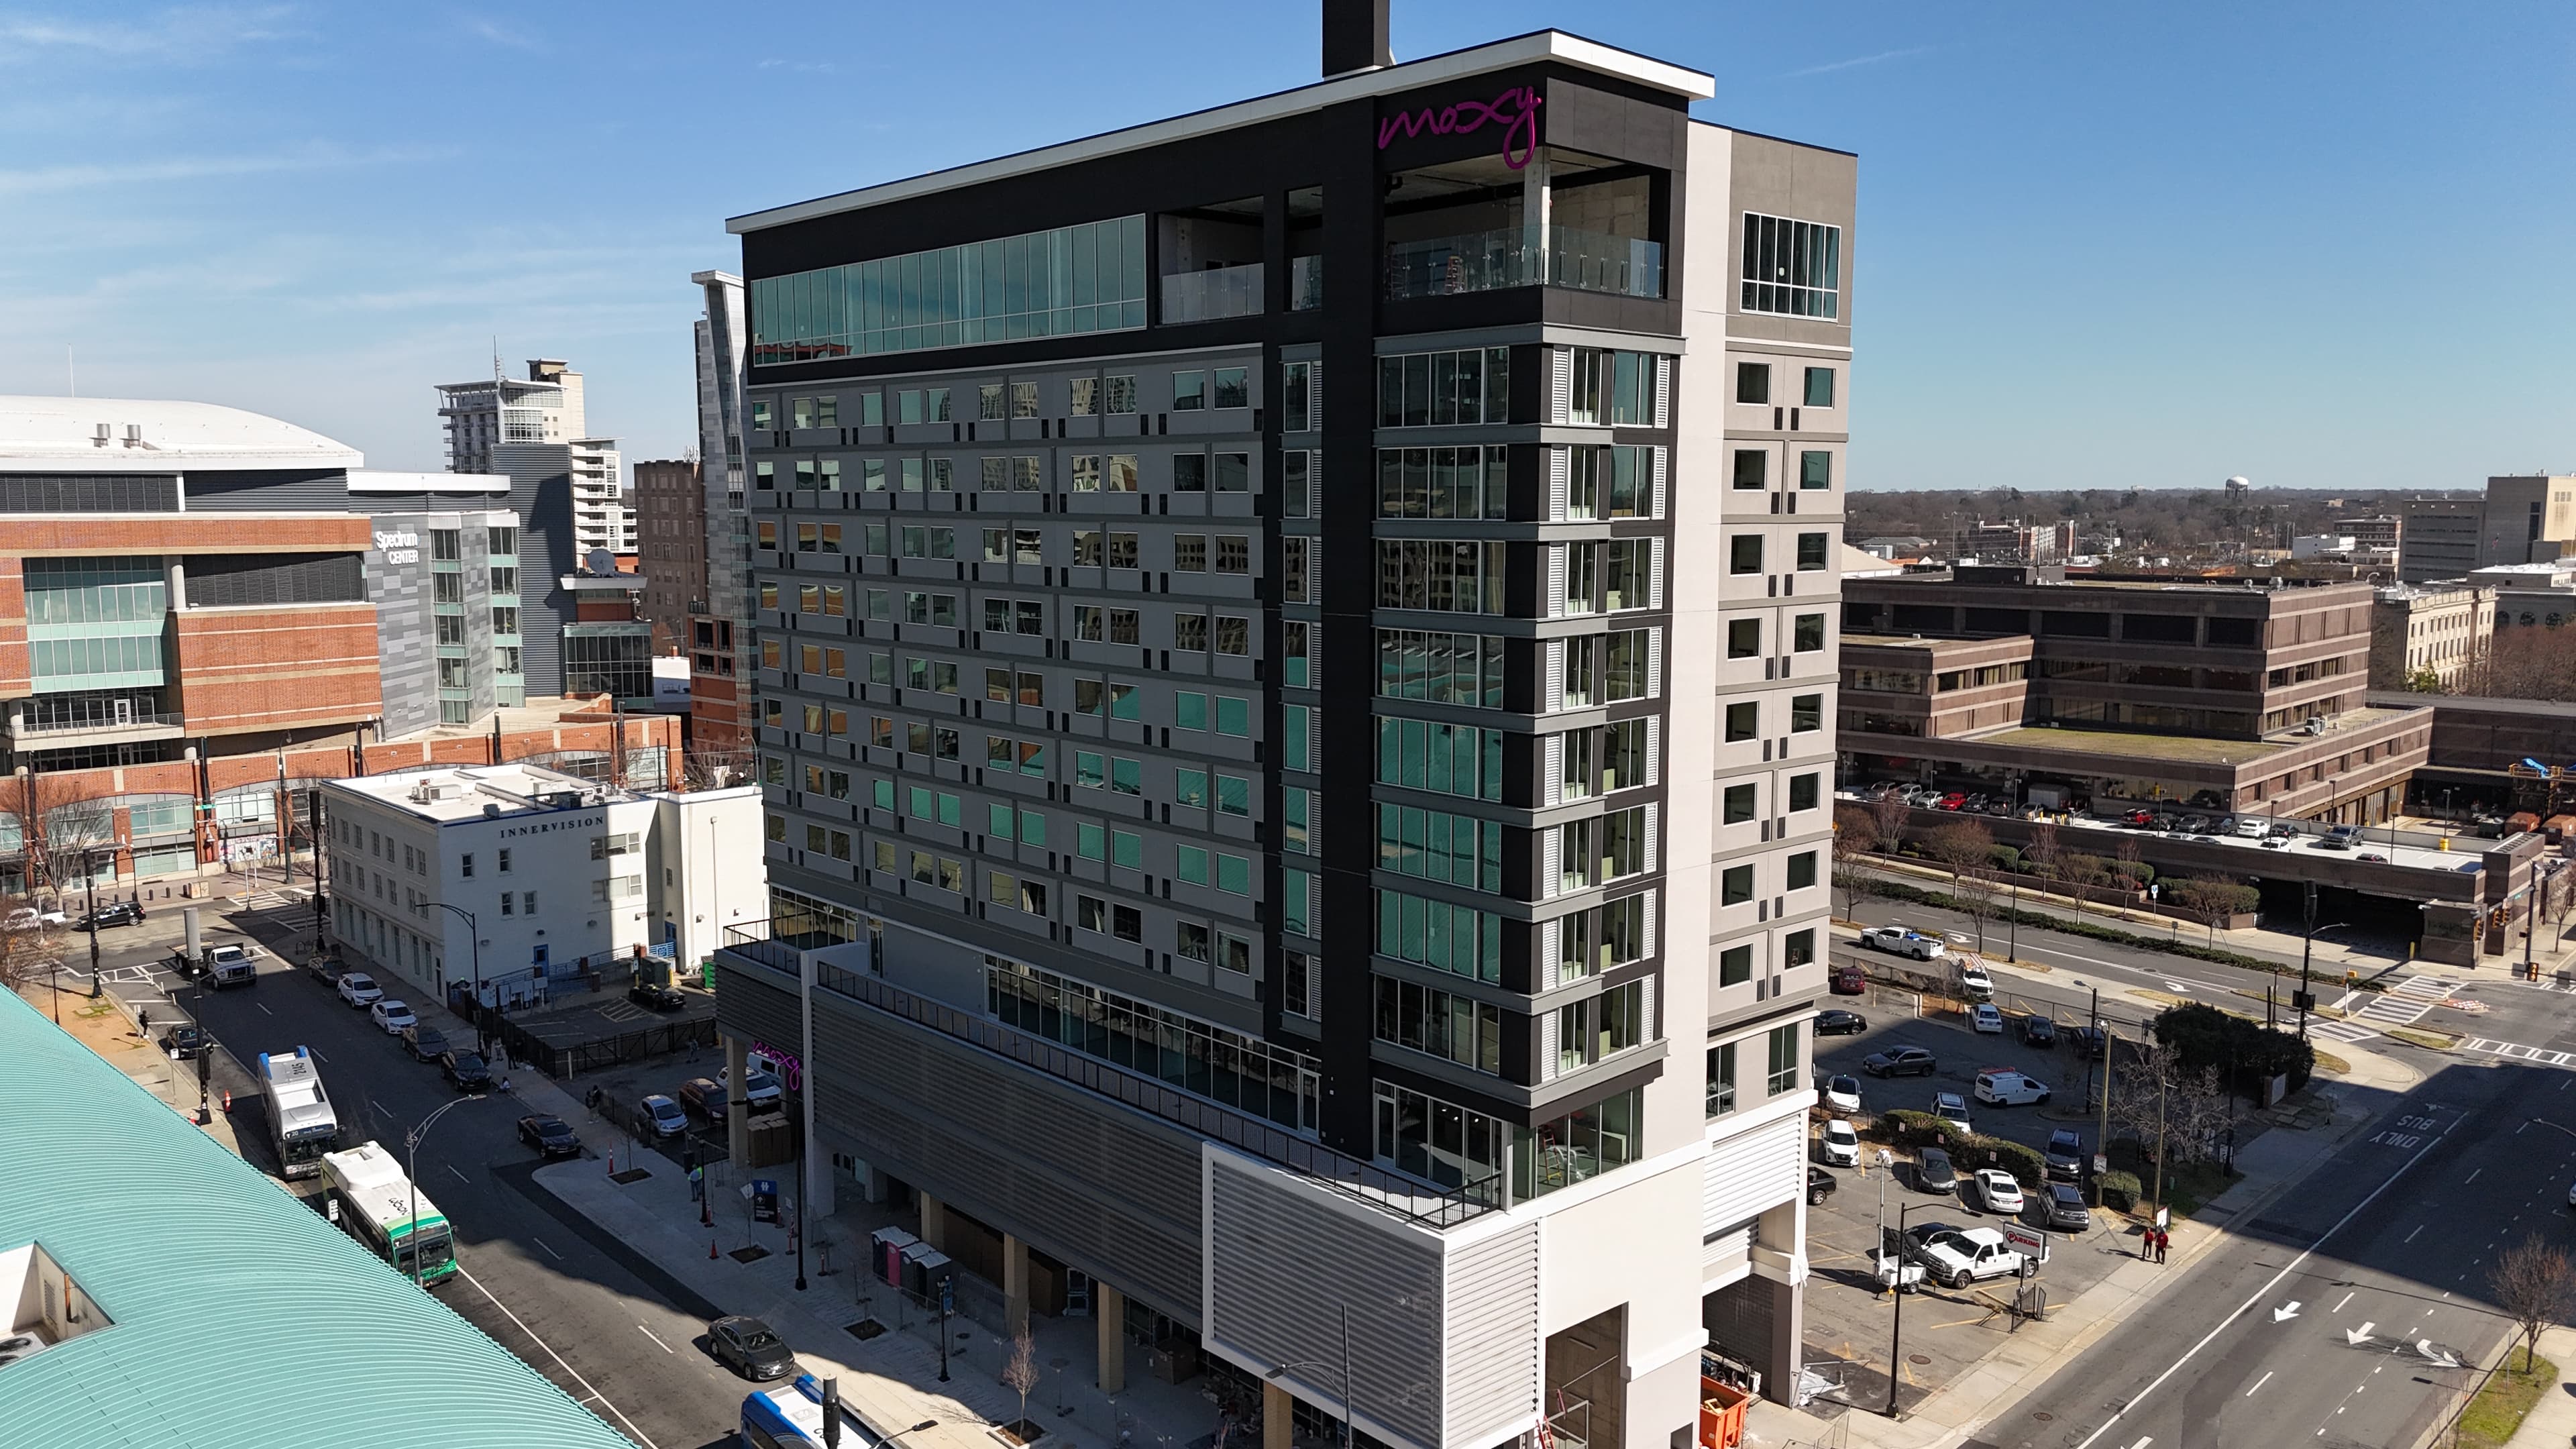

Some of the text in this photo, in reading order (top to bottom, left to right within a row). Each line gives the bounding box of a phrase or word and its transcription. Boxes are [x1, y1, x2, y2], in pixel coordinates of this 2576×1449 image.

[1378, 86, 1542, 170] moxy
[376, 530, 418, 552] Spectrum
[388, 549, 419, 565] CENTER
[500, 816, 603, 838] INNERVISION
[752, 1041, 800, 1091] moxy
[2397, 1115, 2436, 1130] BUS
[2369, 1131, 2420, 1148] ONLY
